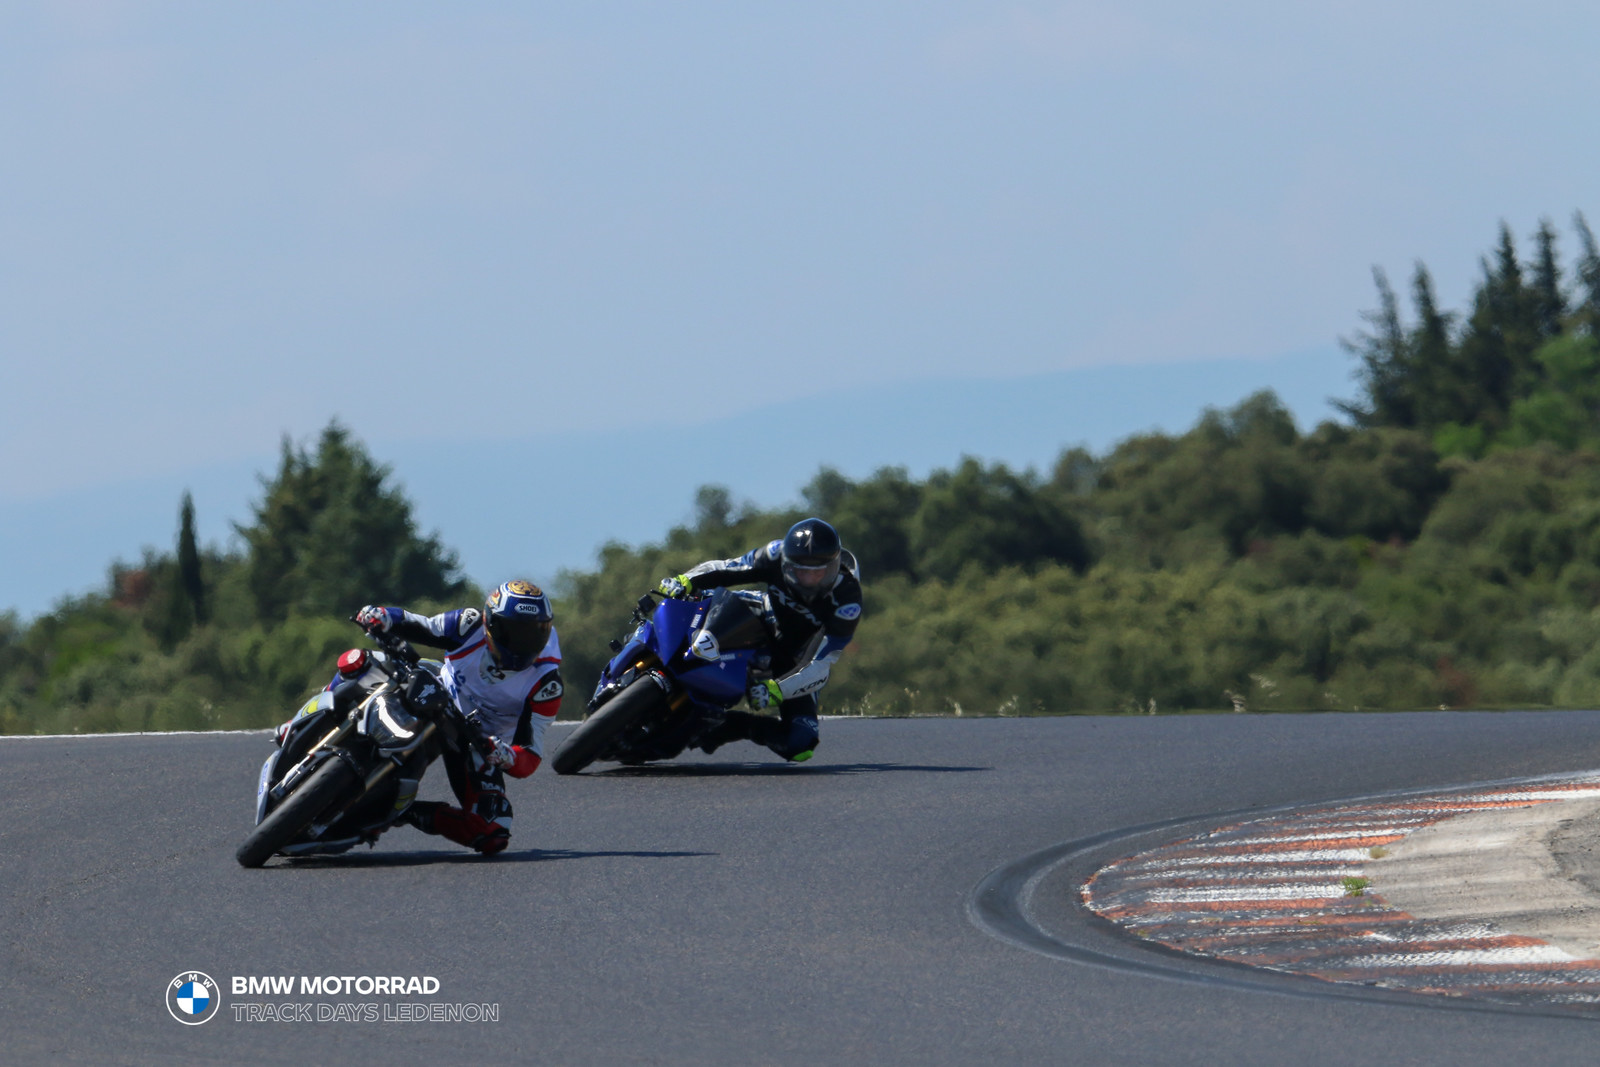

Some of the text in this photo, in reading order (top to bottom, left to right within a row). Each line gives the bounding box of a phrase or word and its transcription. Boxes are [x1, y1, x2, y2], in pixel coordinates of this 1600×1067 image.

[518, 604, 537, 613] SHOEI
[699, 635, 715, 651] 77
[792, 675, 828, 697] IXON
